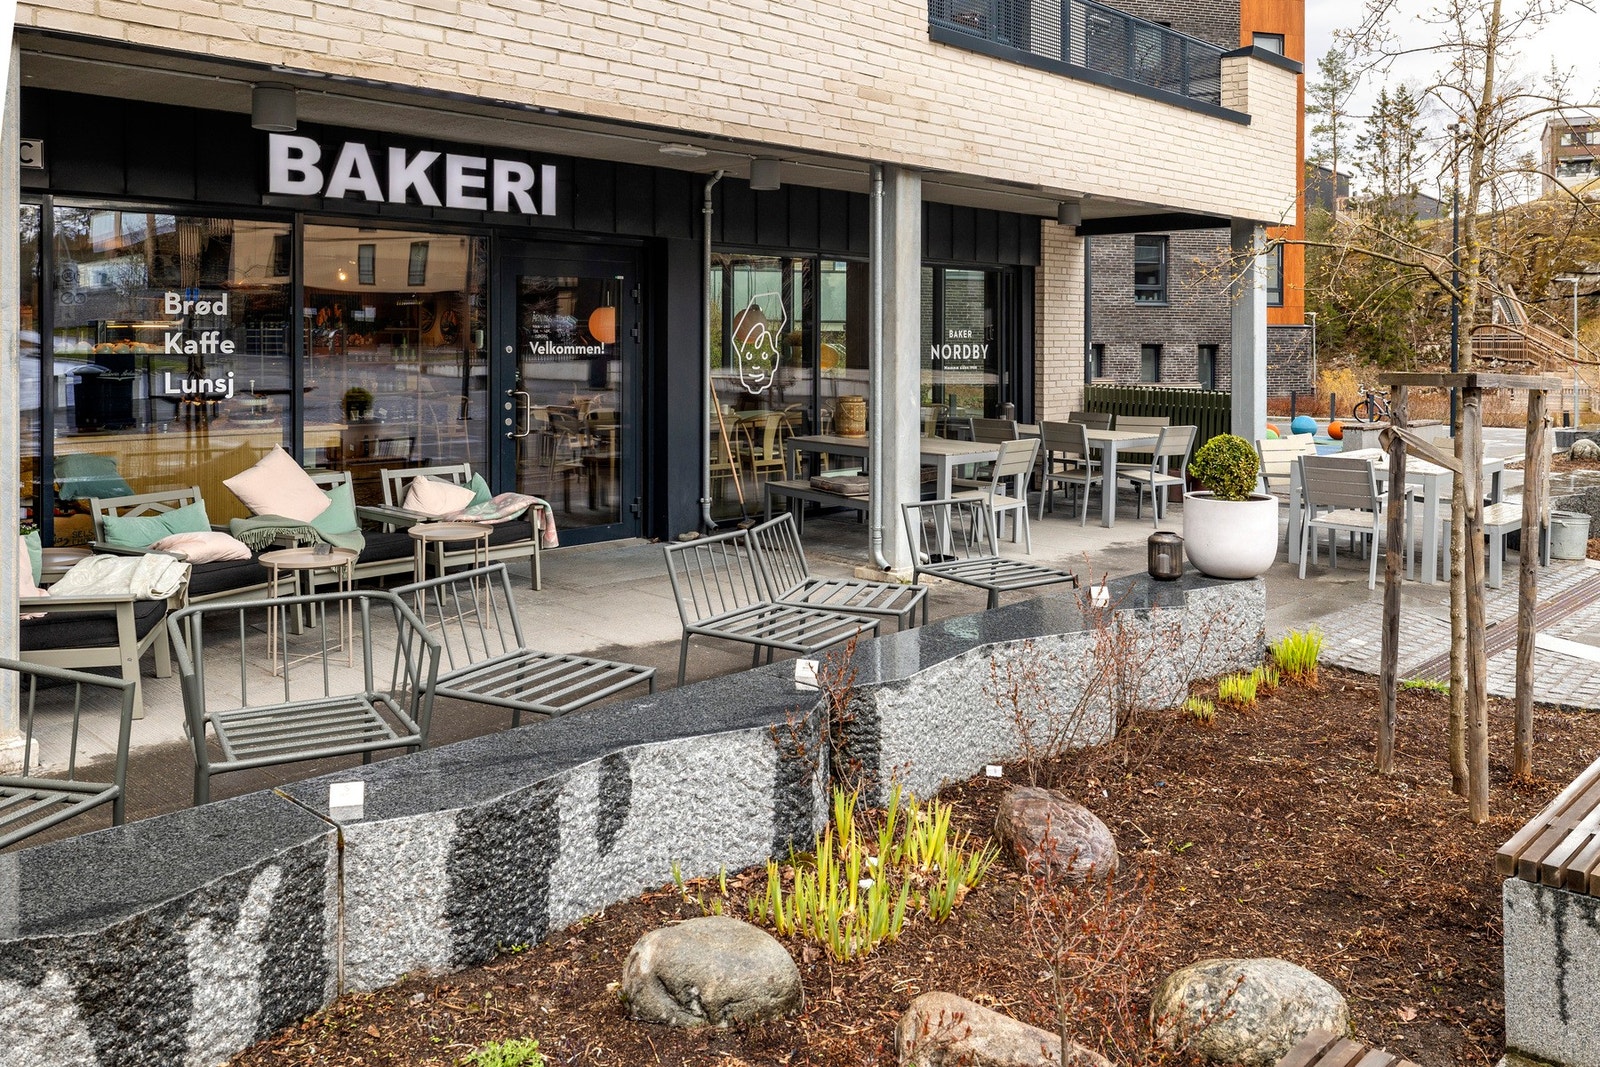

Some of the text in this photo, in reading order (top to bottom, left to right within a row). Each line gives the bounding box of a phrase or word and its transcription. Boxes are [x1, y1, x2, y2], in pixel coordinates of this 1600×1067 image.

[269, 133, 556, 216] BAKERI
[165, 292, 227, 315] Brød
[165, 331, 235, 354] Kaffe
[949, 330, 972, 338] BAKER
[529, 341, 605, 354] Velkommen!
[931, 344, 988, 360] NORDBY
[165, 371, 234, 399] Lunsj
